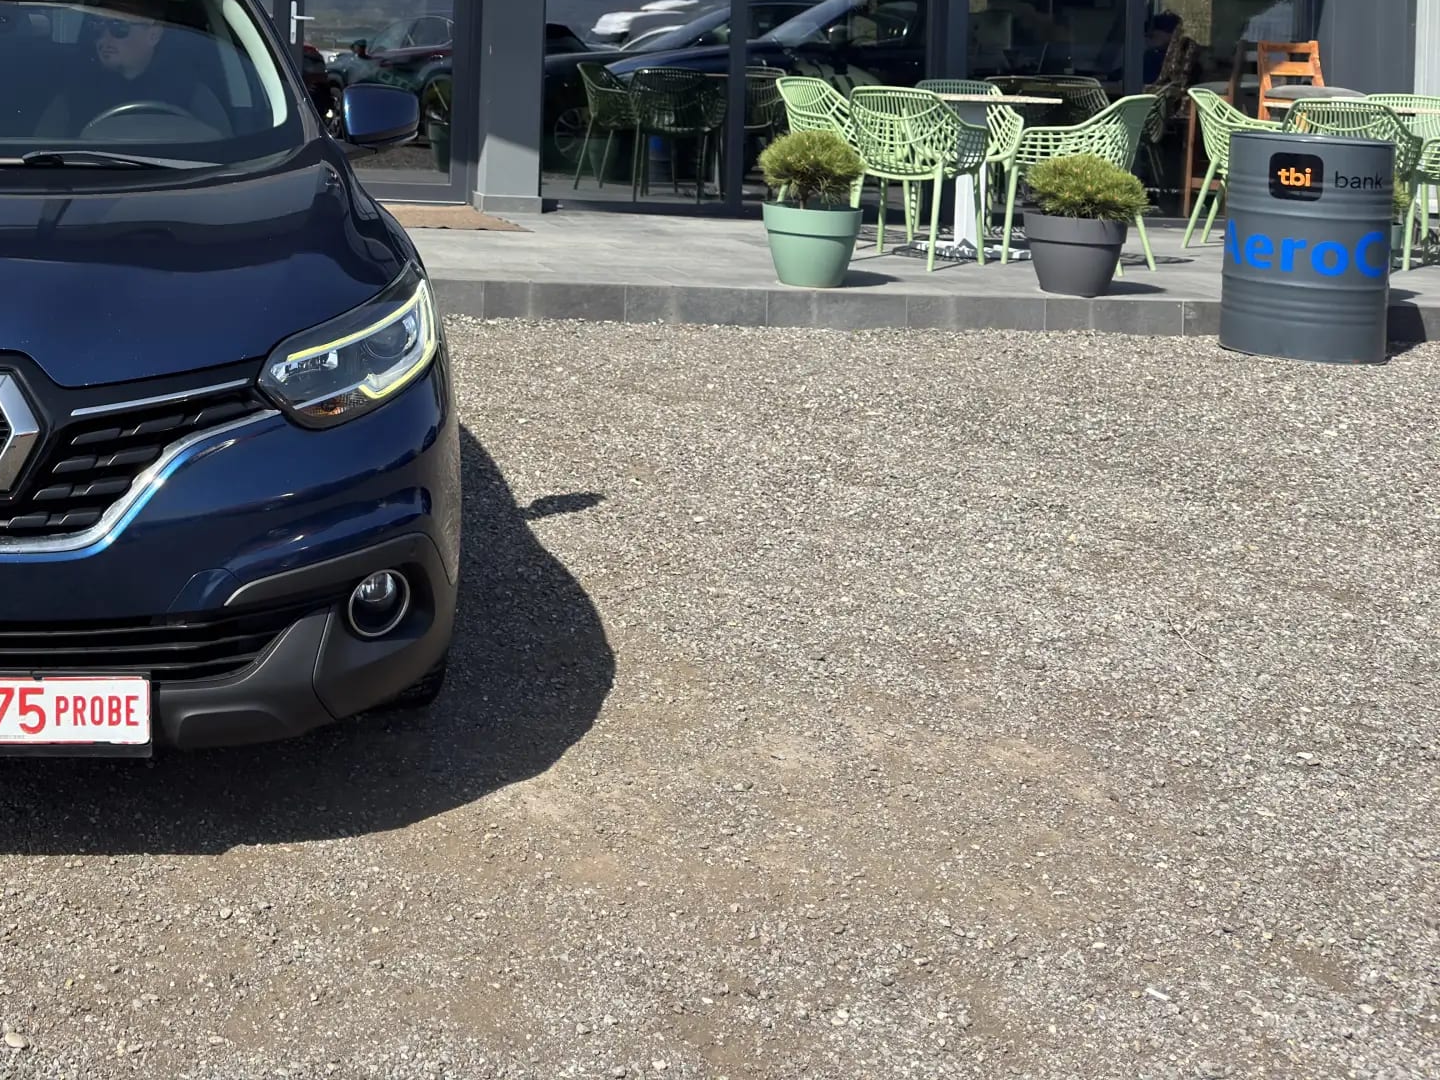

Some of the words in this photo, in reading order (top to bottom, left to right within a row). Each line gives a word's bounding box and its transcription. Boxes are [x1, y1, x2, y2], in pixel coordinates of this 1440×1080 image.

[1278, 167, 1312, 187] tbi
[1334, 171, 1384, 190] bank
[55, 695, 140, 727] PROBE
